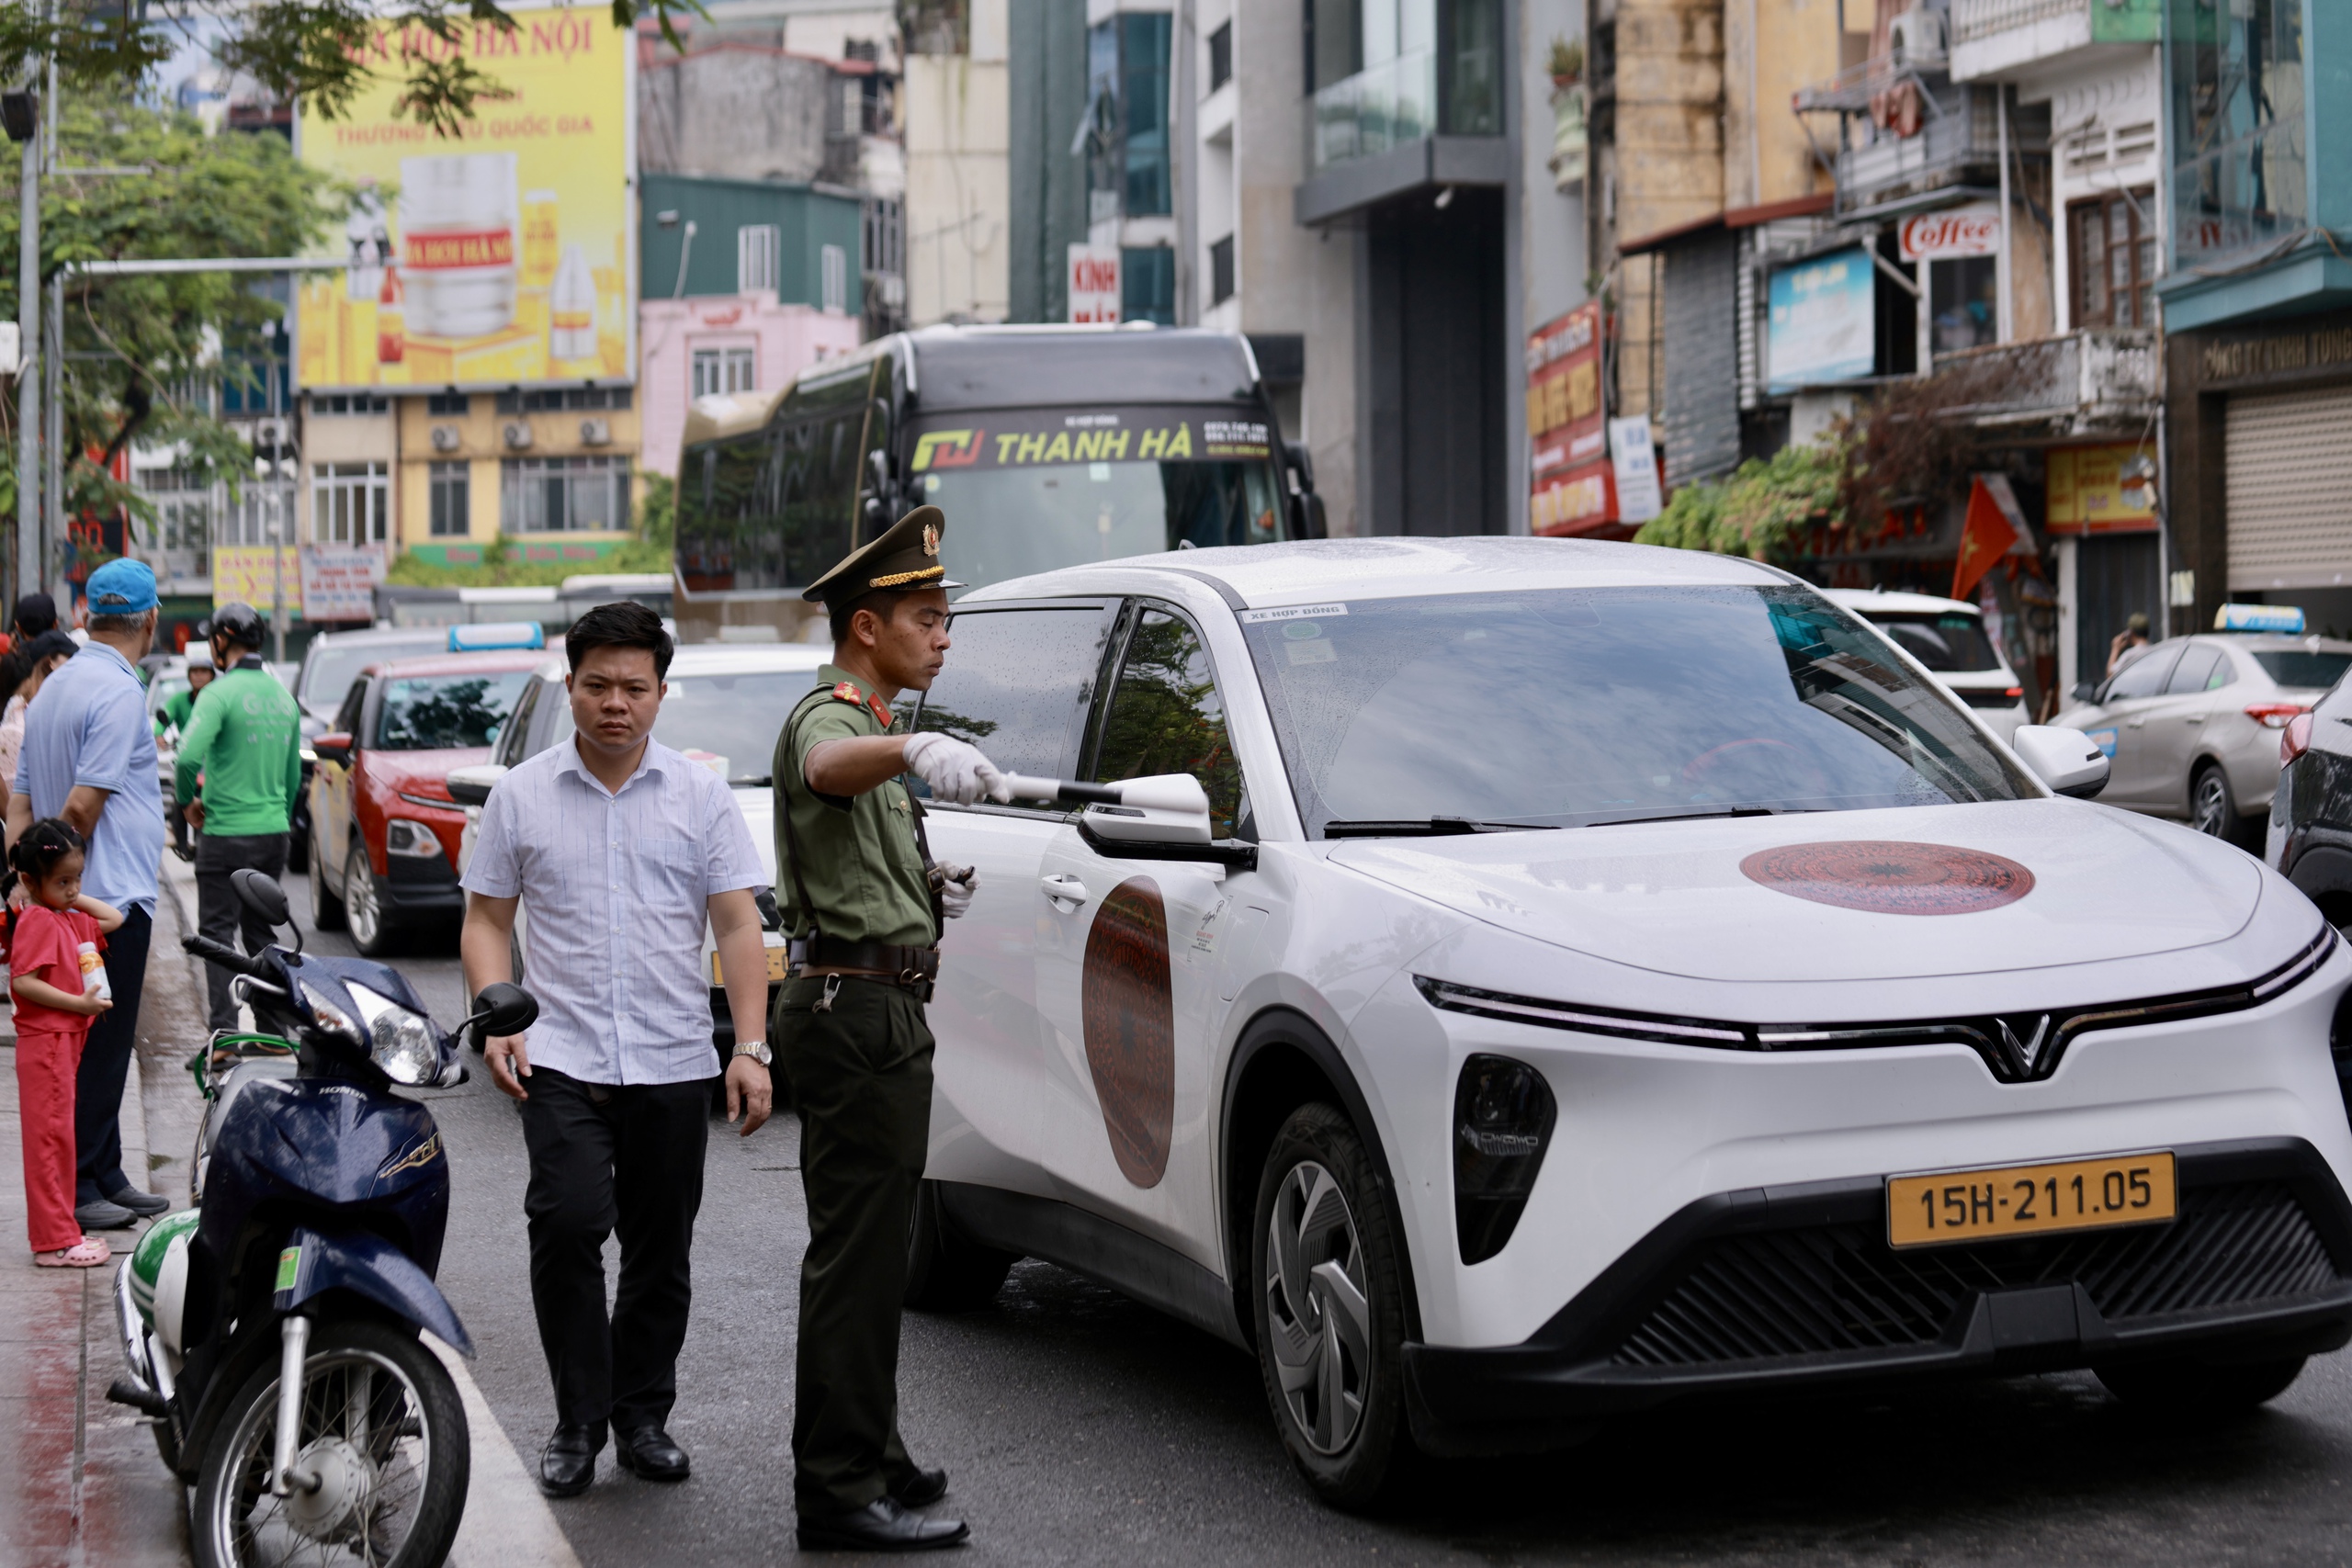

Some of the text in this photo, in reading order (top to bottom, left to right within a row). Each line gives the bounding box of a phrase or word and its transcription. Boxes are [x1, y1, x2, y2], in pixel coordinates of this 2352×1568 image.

[529, 9, 594, 63] NỘI
[433, 116, 484, 142] HU
[489, 111, 552, 140] QUỐC
[556, 114, 594, 136] GIA
[1902, 213, 1996, 258] Coffee
[995, 429, 1131, 464] THANH
[1137, 421, 1193, 459] HÀ
[1250, 612, 1268, 620] XE
[1272, 610, 1298, 618] HỢP
[318, 1085, 368, 1101] HONDA
[1921, 1167, 2152, 1229] 15H-211.05
